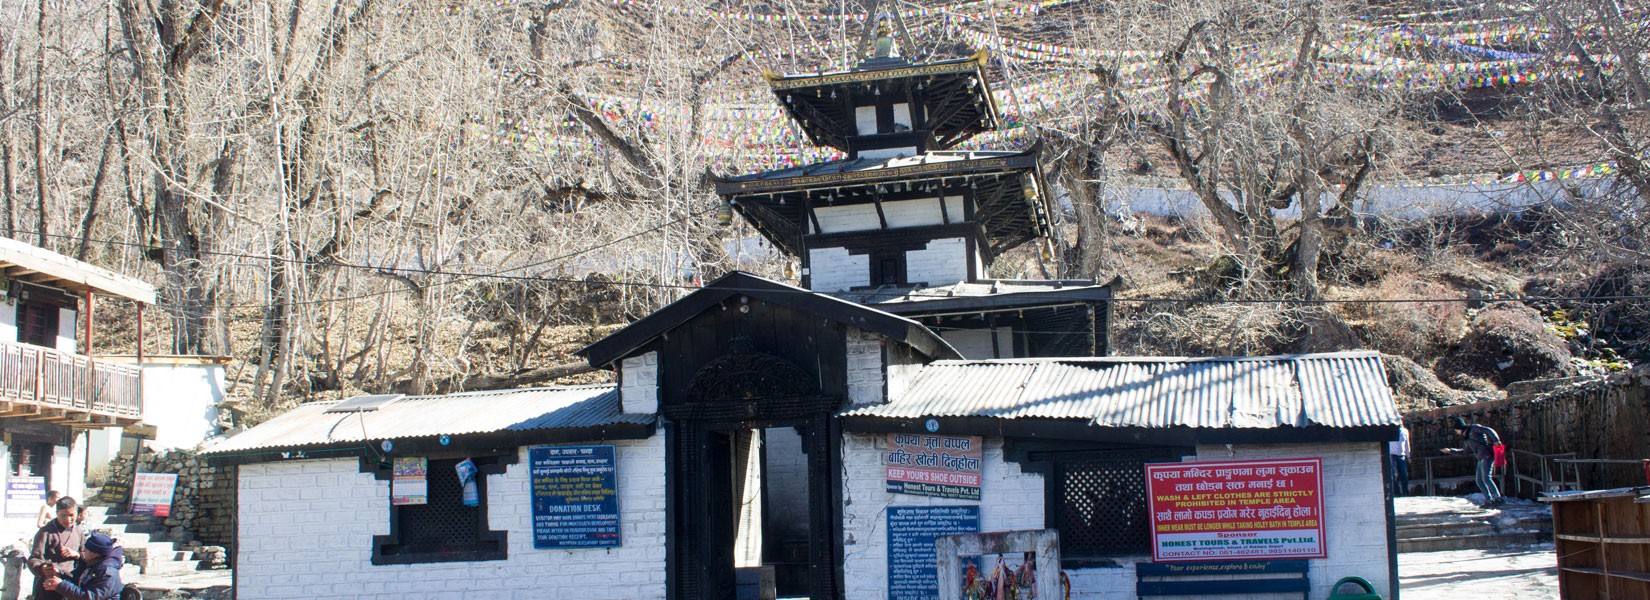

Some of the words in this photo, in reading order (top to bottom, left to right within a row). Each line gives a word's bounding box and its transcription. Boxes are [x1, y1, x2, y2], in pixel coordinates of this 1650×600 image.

[895, 434, 920, 448] कृपया
[924, 436, 940, 451] जुता
[944, 438, 970, 449] चप्पल
[888, 449, 912, 464] बाहिर
[915, 452, 938, 466] खोली
[941, 453, 979, 470] दिनुहोला
[888, 469, 905, 478] KEEP
[906, 470, 929, 481] YOUR'S
[930, 473, 948, 482] SHOE
[949, 474, 977, 484] OUTSIDE
[1153, 471, 1180, 481] कृपया
[1183, 468, 1212, 478] मन्दिर
[1256, 467, 1275, 477] लुगा
[1278, 466, 1314, 476] सुकाउन
[1175, 483, 1193, 491] तथा
[1156, 509, 1172, 521] साथै
[1174, 508, 1192, 520] लामो
[1217, 507, 1237, 520] प्रयोग
[1239, 506, 1257, 518] गरेर
[1293, 505, 1310, 517] होला
